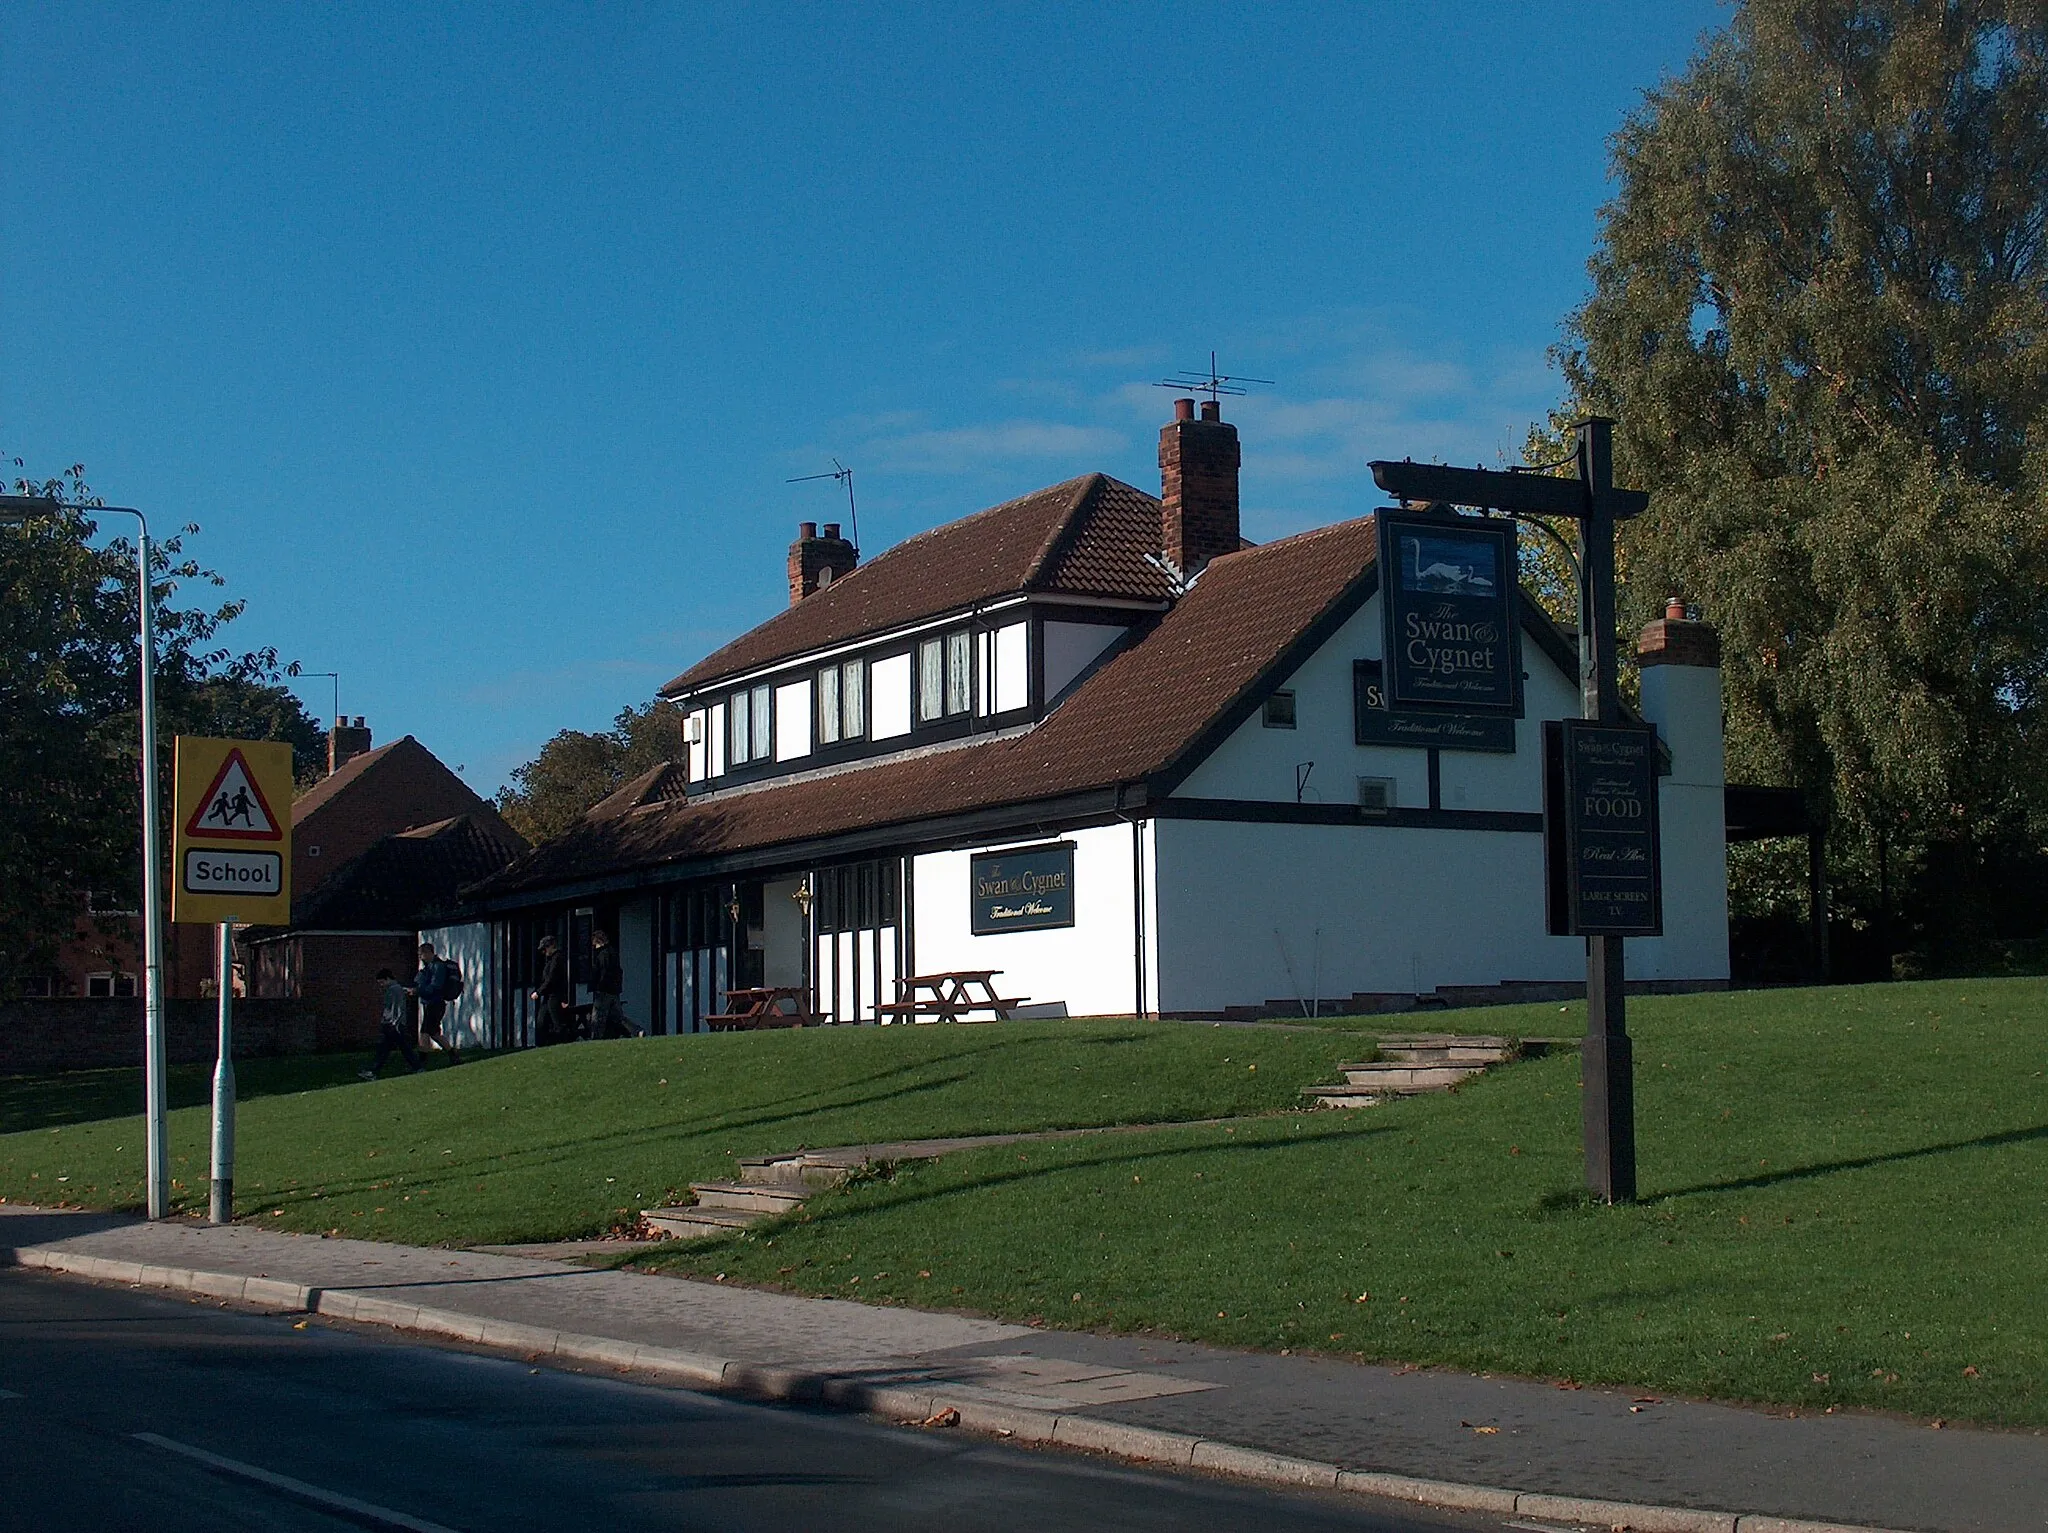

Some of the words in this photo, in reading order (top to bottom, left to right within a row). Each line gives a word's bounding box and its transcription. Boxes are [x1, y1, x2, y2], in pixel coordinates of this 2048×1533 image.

[1430, 602, 1460, 619] The
[1406, 612, 1471, 641] Swan
[1407, 639, 1495, 675] Cygnet
[1388, 719, 1441, 735] Traditional
[1443, 722, 1485, 737] Welcome
[1577, 740, 1602, 753] Swan
[1612, 742, 1644, 757] Cygnet
[1584, 796, 1642, 818] FOOD
[1583, 846, 1616, 861] Real
[1616, 847, 1646, 861] Ales
[196, 861, 271, 883] School
[978, 877, 1008, 897] Swan
[1022, 870, 1066, 896] Cygnet
[1583, 891, 1611, 901] LARGE
[1613, 891, 1648, 902] SCREEN
[989, 905, 1025, 919] Traditional
[1024, 899, 1053, 915] Welcome
